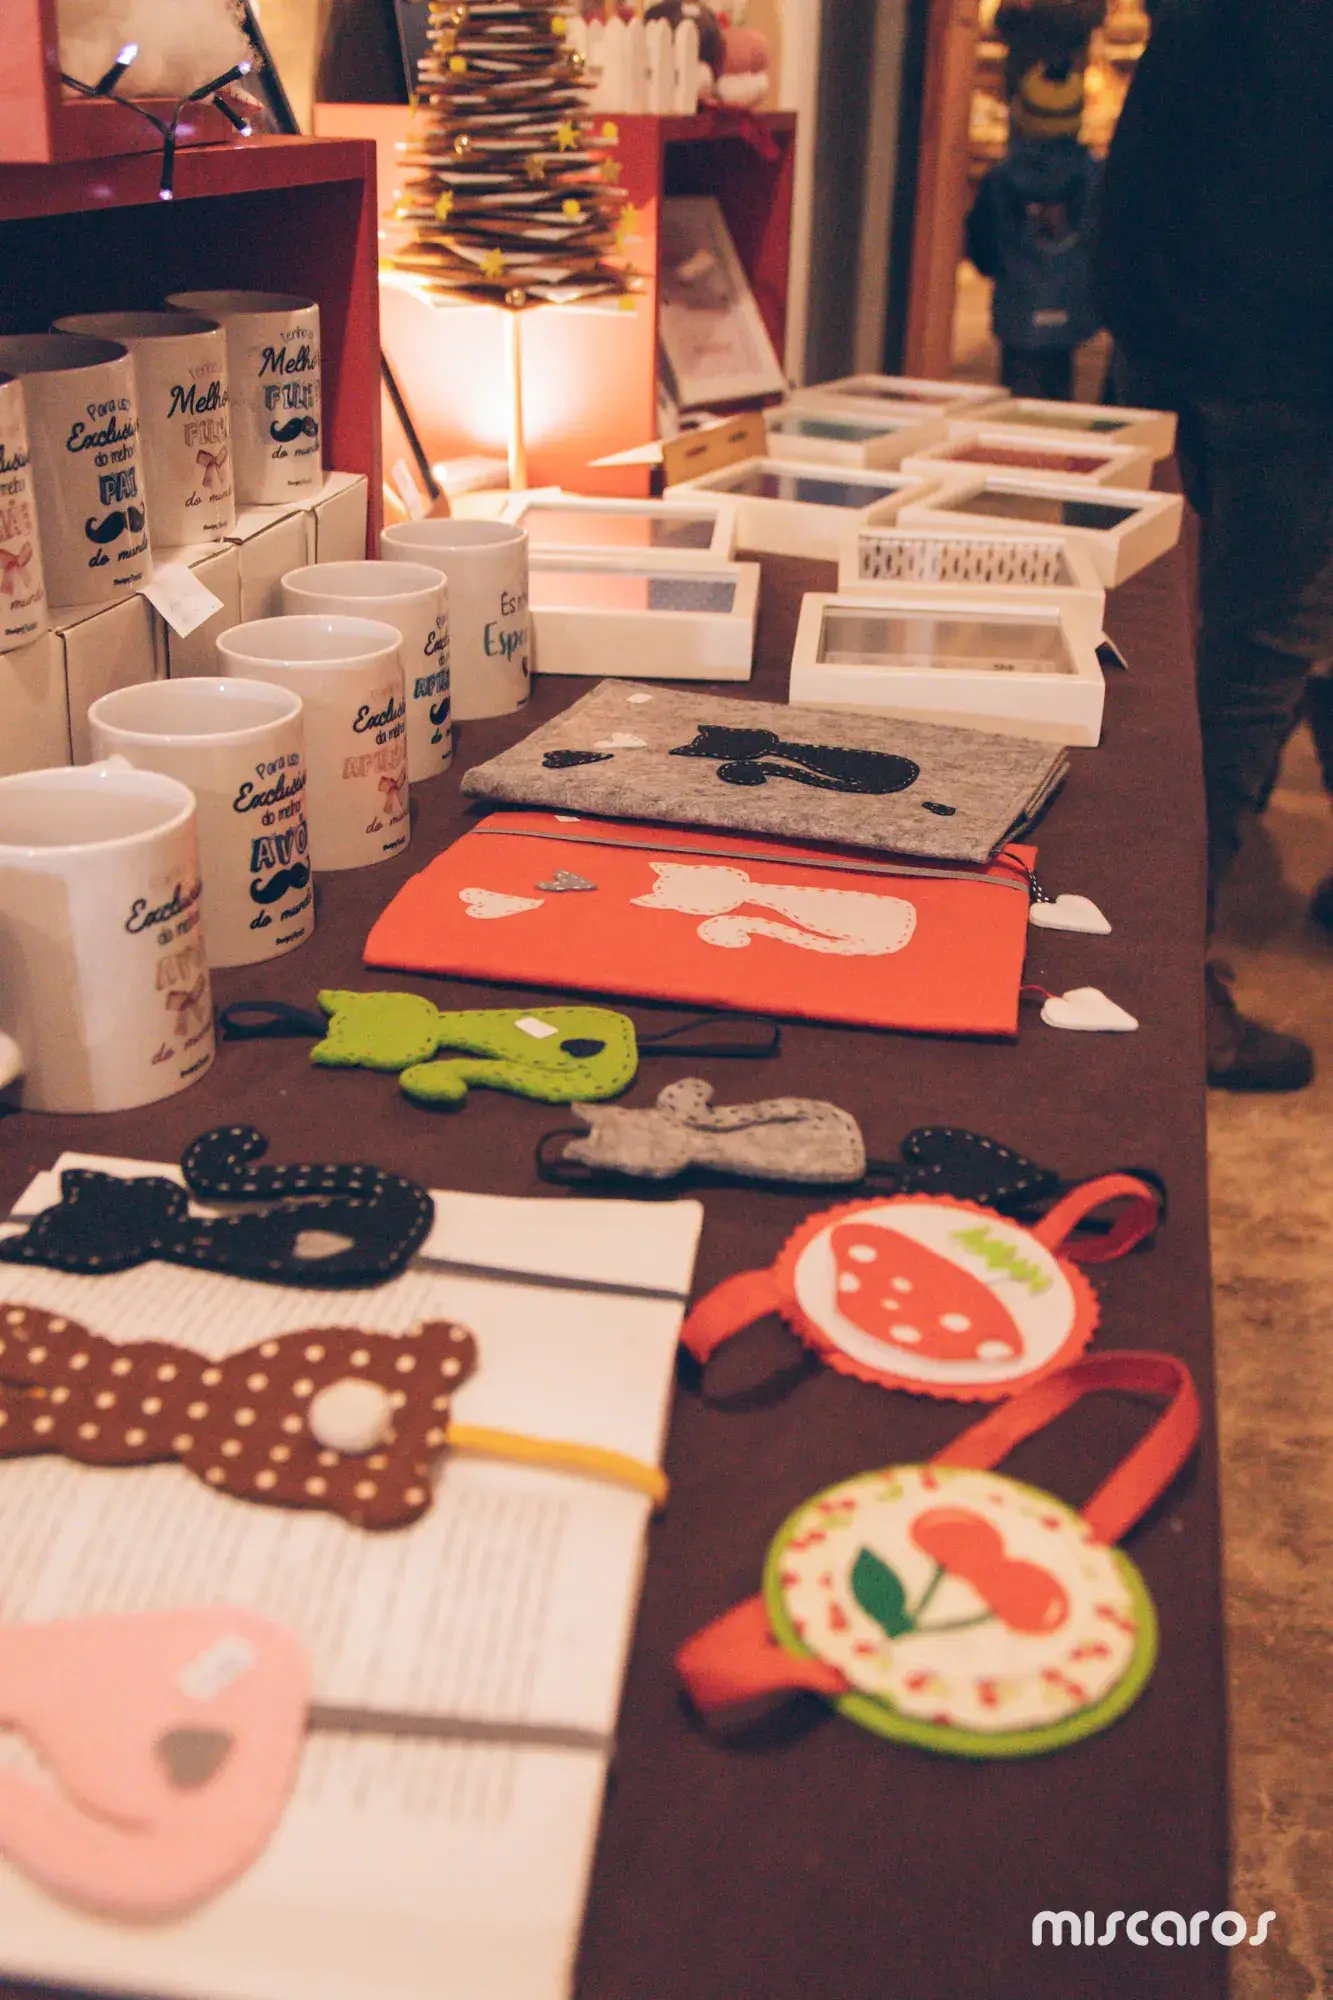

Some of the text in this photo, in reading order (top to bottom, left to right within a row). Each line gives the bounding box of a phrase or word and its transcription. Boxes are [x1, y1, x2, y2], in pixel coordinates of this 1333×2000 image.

[167, 380, 229, 419] Melho
[95, 450, 108, 467] do
[100, 466, 137, 506] PAI
[185, 491, 202, 507] do
[88, 549, 110, 568] do
[262, 809, 275, 826] do
[250, 910, 272, 929] do
